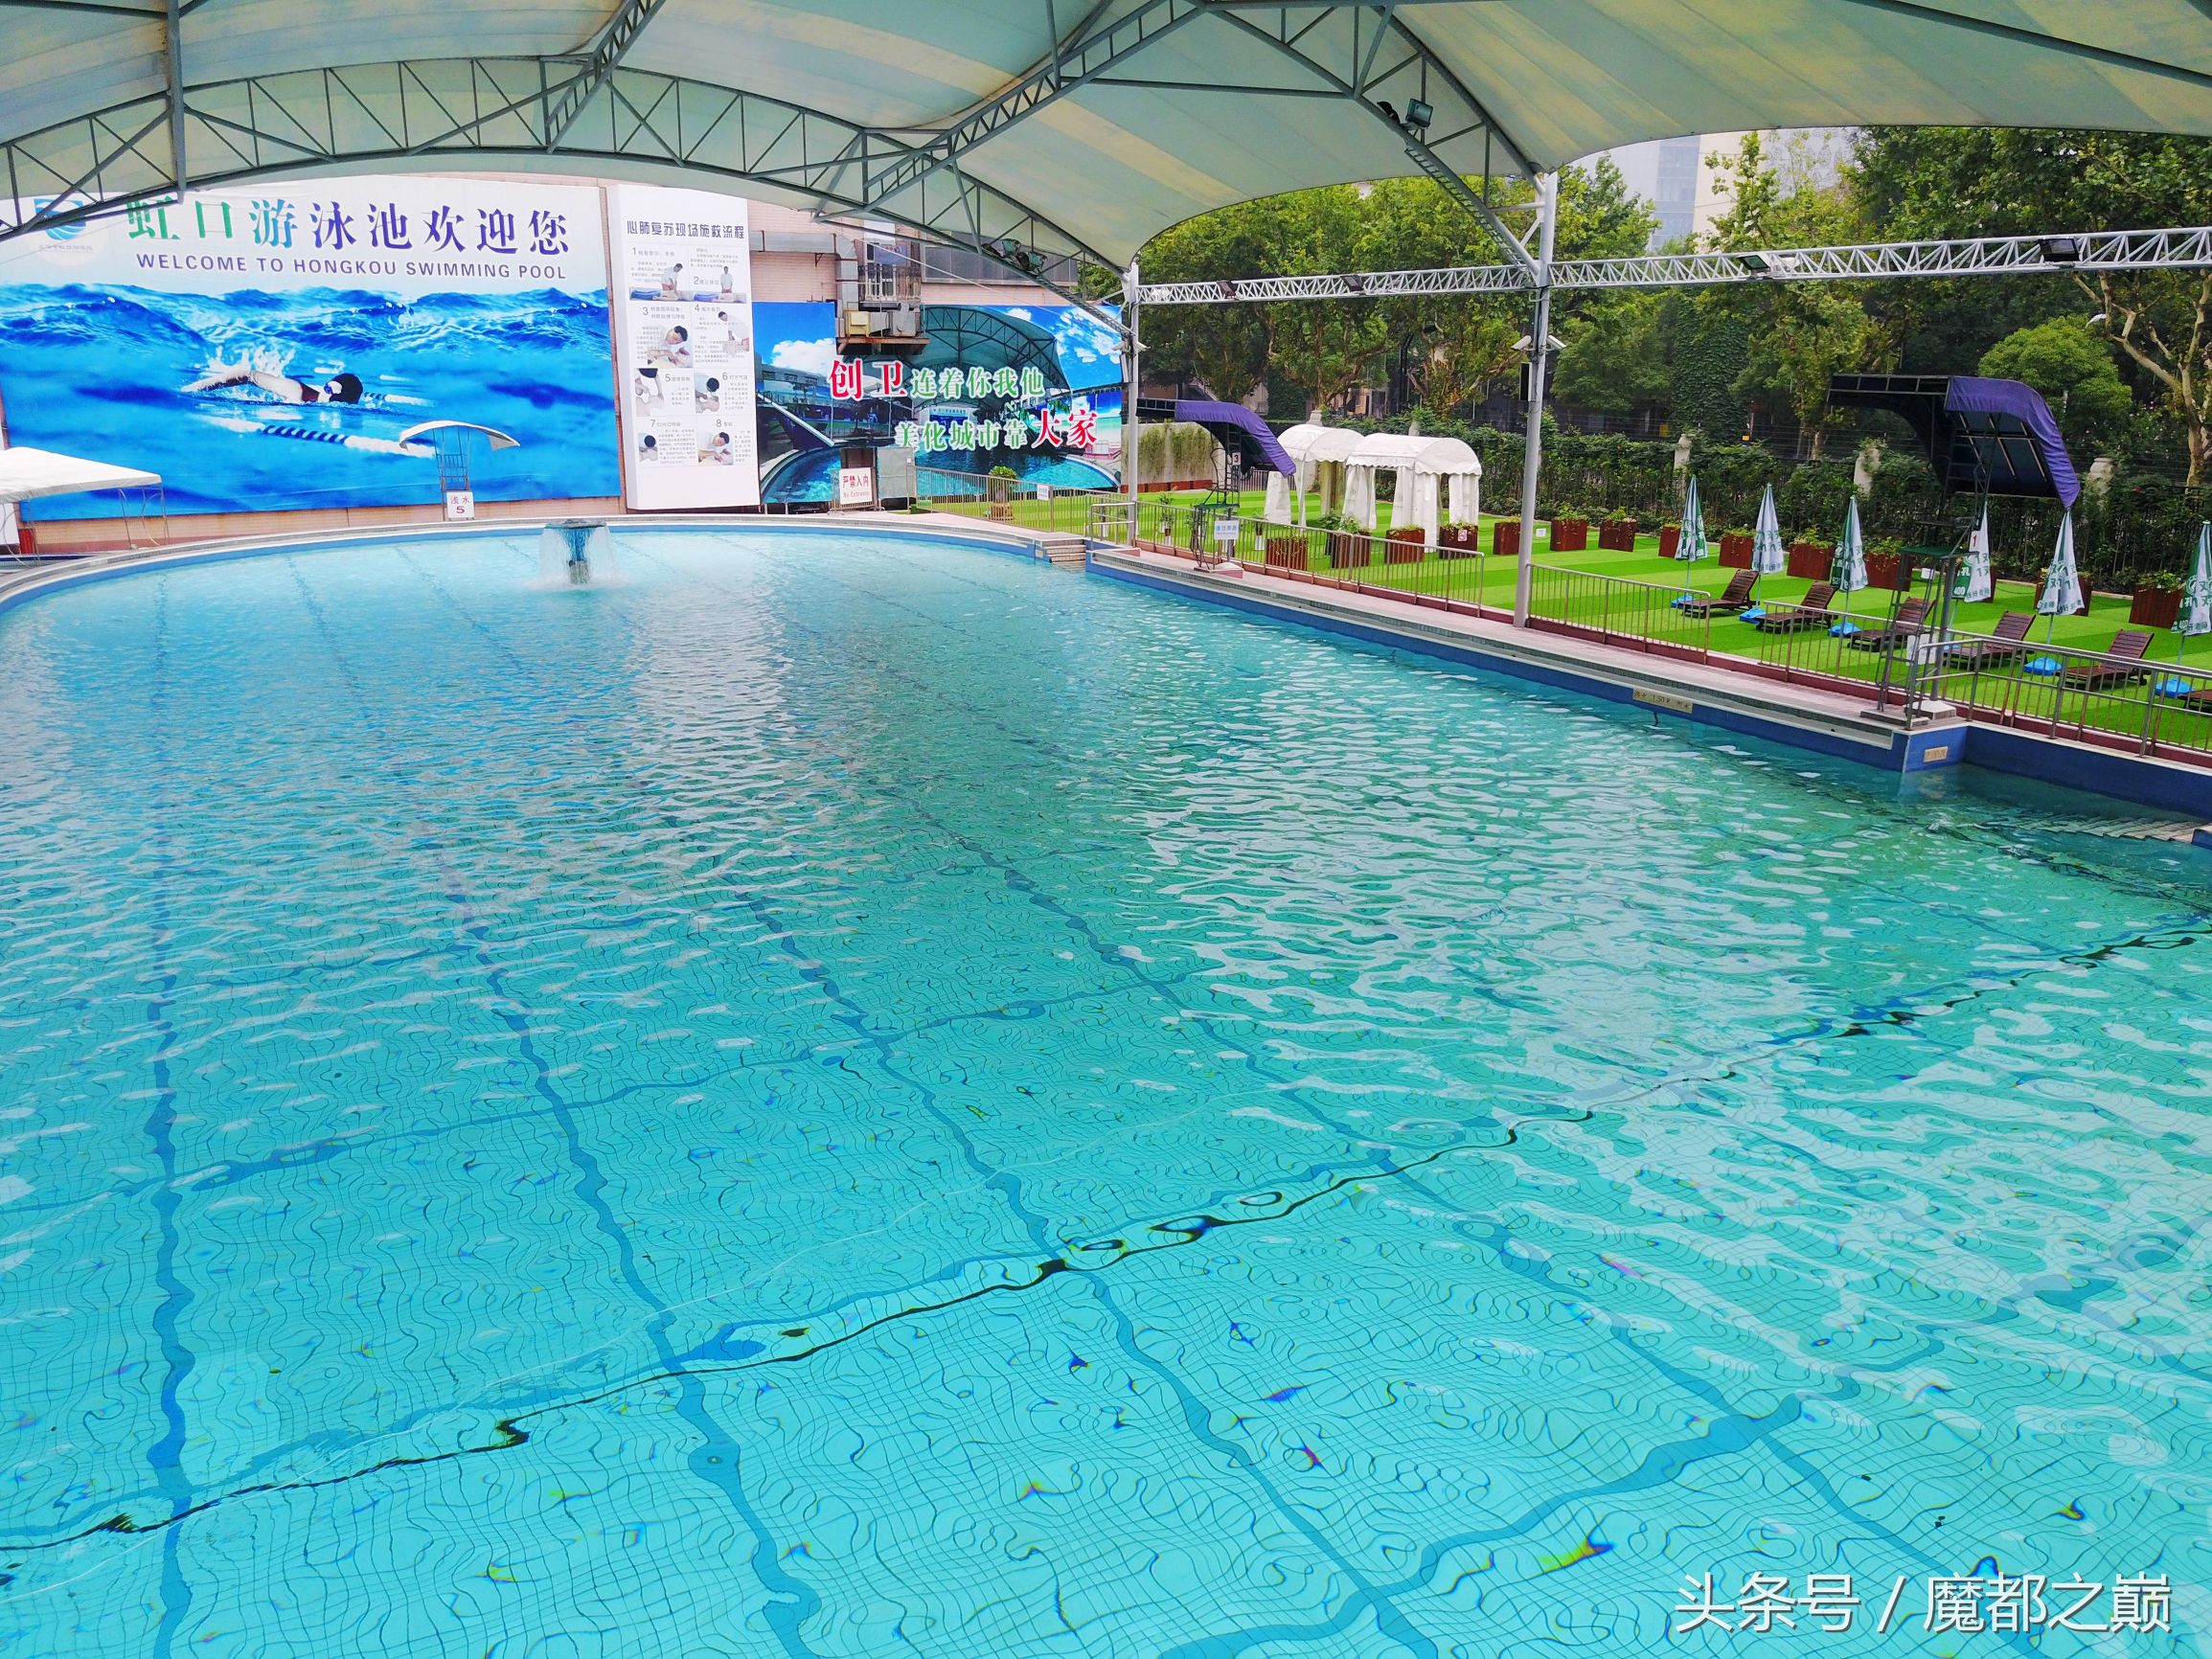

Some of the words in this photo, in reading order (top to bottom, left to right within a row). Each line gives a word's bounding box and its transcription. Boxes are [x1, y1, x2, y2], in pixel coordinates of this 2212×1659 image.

[125, 194, 569, 256] 虹口游泳池欢迎您
[627, 220, 744, 239] 心肺复苏现场施救流程
[632, 246, 637, 256] 1
[136, 254, 247, 271] WELCOME
[257, 258, 284, 272] TO
[294, 259, 397, 275] HONGKOU
[406, 261, 511, 278] SWIMMING
[518, 264, 567, 280] POOL
[694, 276, 699, 285] 2
[642, 307, 649, 316] 3
[694, 304, 700, 312] 4
[665, 373, 672, 382] 5
[721, 372, 728, 381] 6
[828, 358, 1045, 400] 创卫连着你我他
[650, 419, 656, 427] 7
[716, 419, 722, 427] 8
[895, 409, 1098, 450] 美化城市靠大家
[1234, 454, 1240, 464] 3
[843, 474, 869, 488] 严禁入内
[451, 495, 469, 505] 浅水
[456, 506, 466, 514] 5
[1972, 534, 1977, 548] 1
